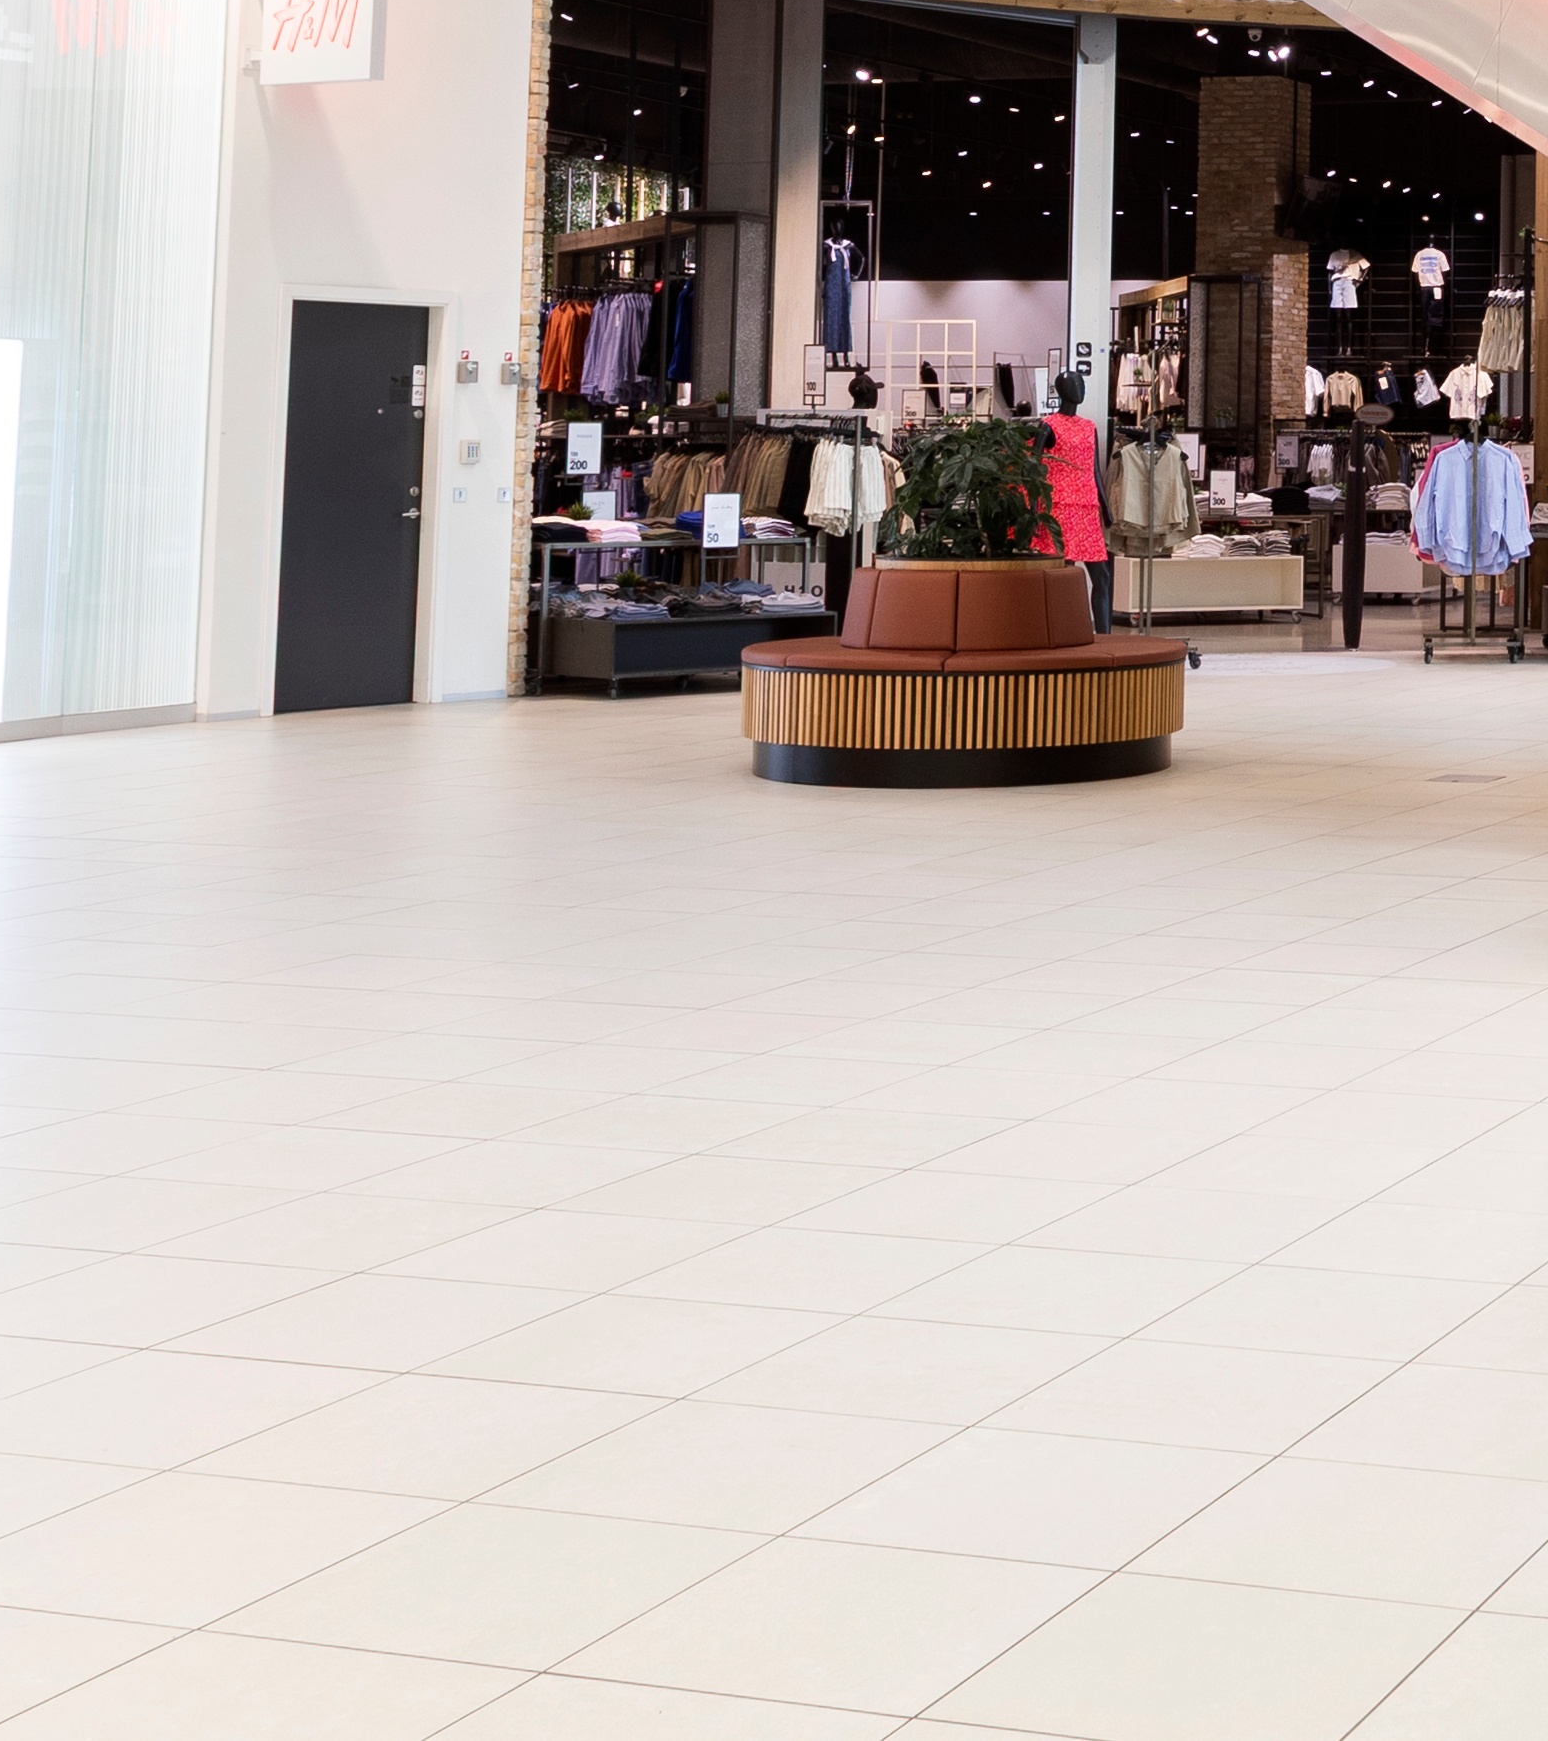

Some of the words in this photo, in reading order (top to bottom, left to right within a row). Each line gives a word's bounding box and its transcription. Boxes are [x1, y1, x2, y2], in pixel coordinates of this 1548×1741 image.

[570, 460, 588, 470] 200
[1212, 497, 1226, 506] 300
[707, 532, 719, 543] 50
